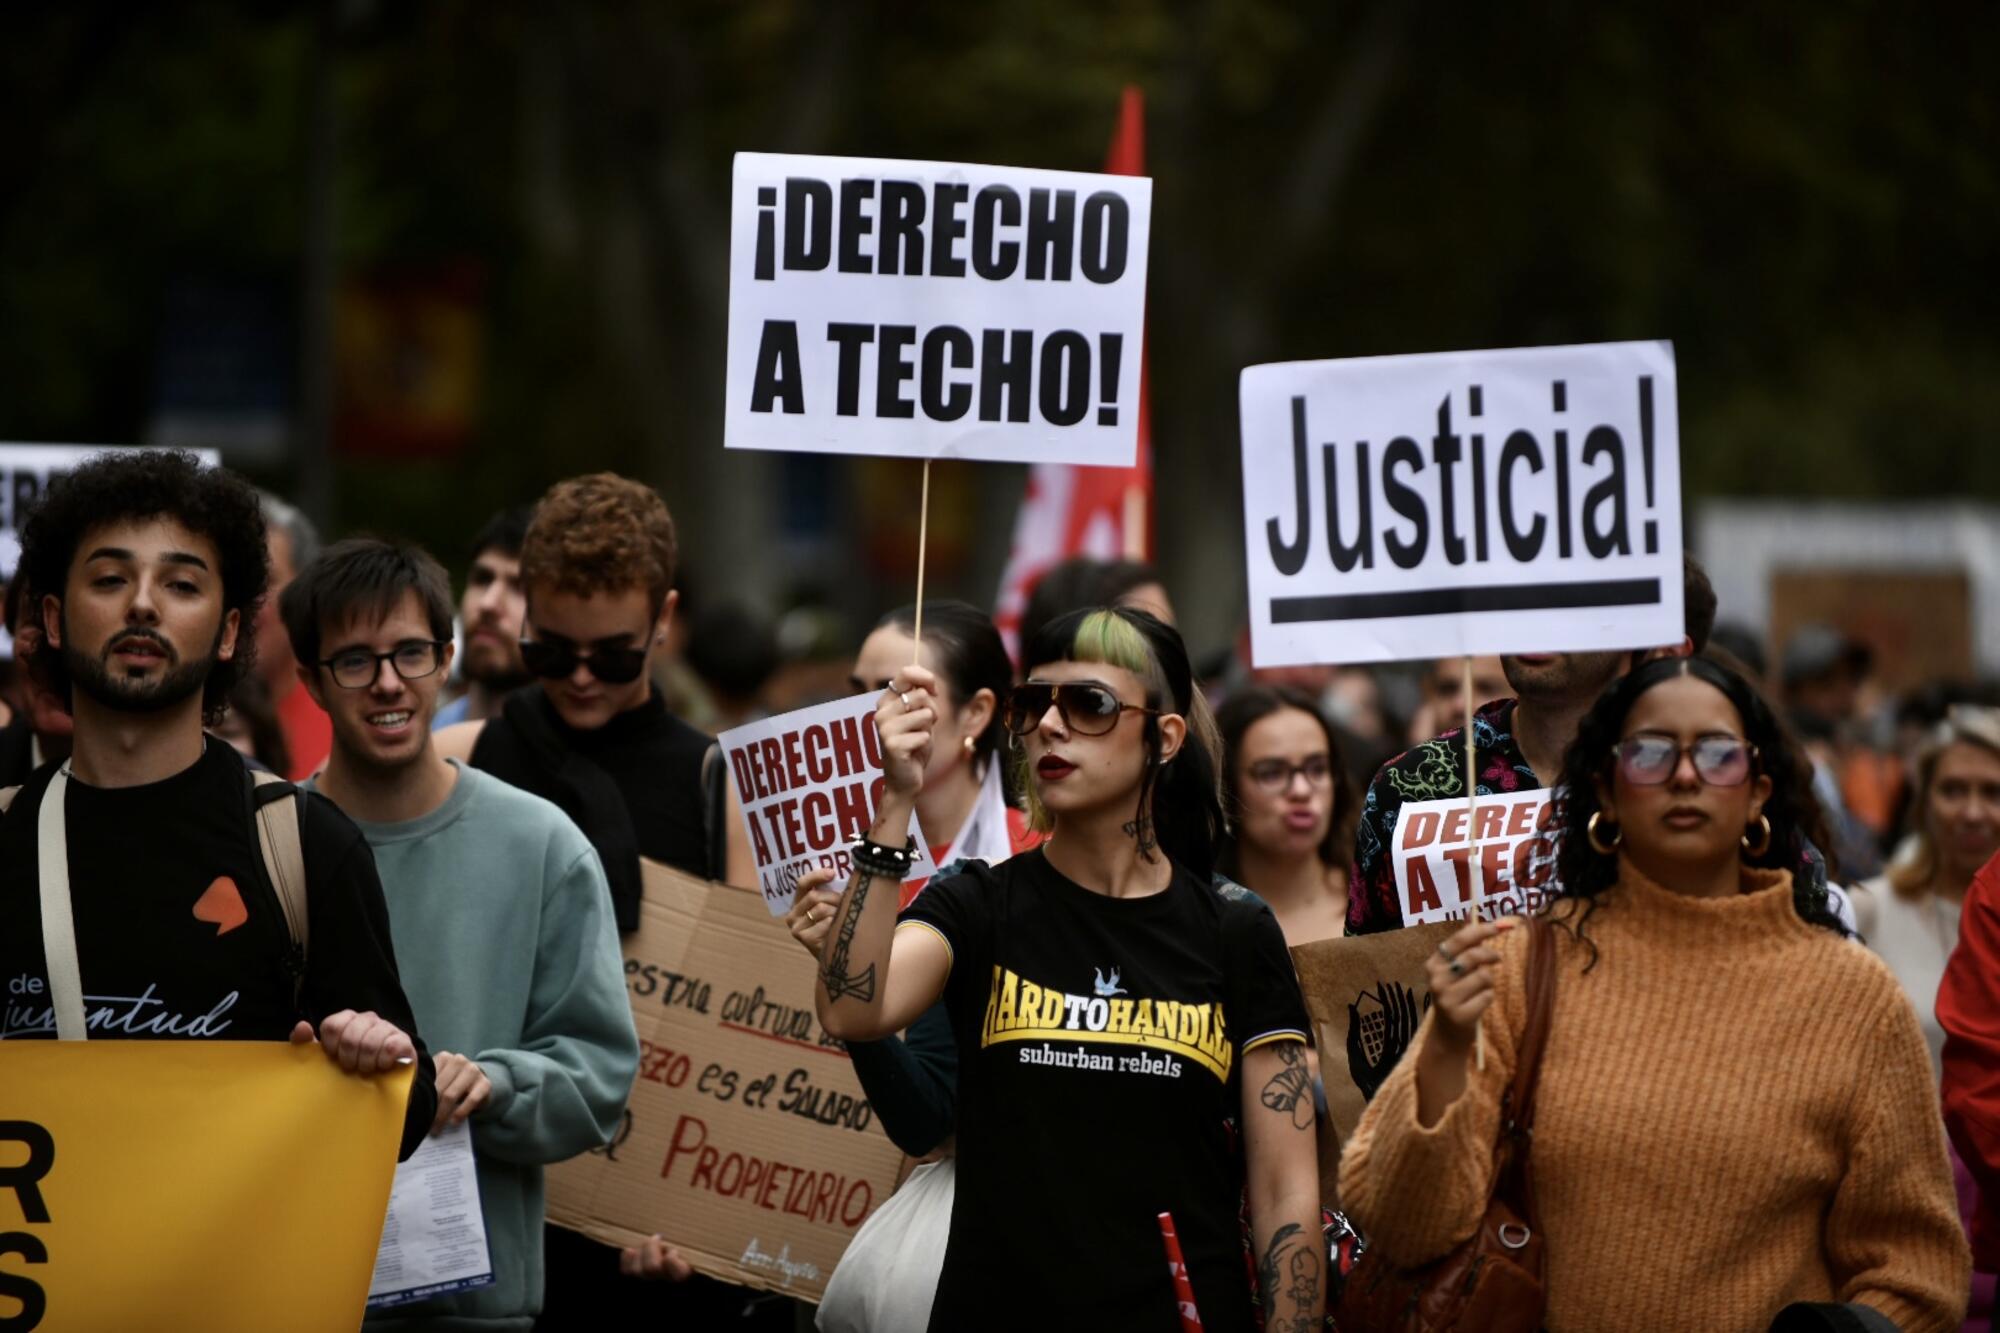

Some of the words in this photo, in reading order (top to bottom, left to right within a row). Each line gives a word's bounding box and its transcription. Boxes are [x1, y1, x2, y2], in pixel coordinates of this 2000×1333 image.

[754, 176, 1131, 284] ¡DERECHO
[750, 319, 805, 414] A
[827, 322, 1123, 427] TECHO!
[1266, 375, 1659, 576] Justicia!
[747, 811, 773, 867] A
[762, 872, 777, 900] A
[1406, 854, 1442, 915] A
[1443, 837, 1565, 903] TEC
[0, 983, 239, 1040] juvntud
[9, 973, 44, 994] de
[697, 1064, 739, 1101] es
[743, 1074, 777, 1108] el
[1020, 1043, 1114, 1071] suburban
[1119, 1052, 1182, 1078] rebels
[661, 1114, 872, 1228] PROPIETARIO
